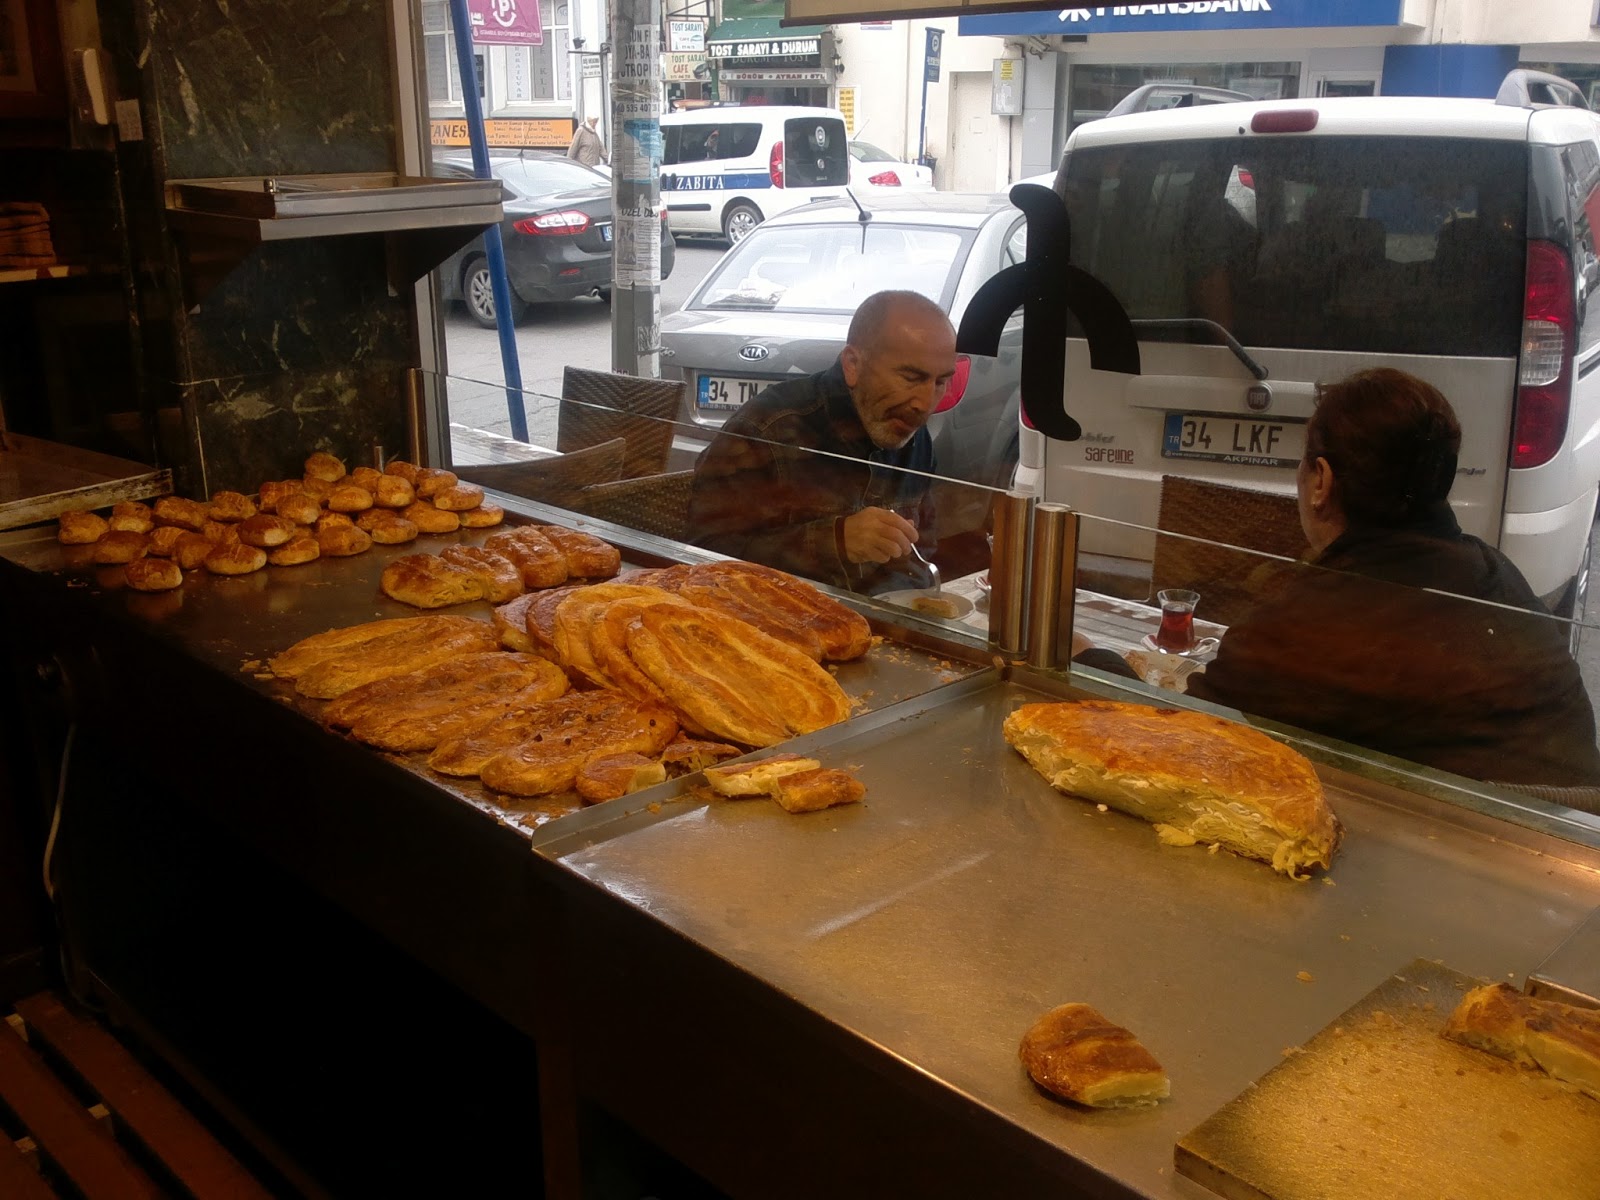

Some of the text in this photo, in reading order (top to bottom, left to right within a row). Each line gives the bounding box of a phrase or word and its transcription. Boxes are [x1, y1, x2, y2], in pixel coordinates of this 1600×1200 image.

[672, 23, 684, 31] TOST
[711, 44, 733, 57] TOST
[737, 42, 770, 56] SARAYI
[771, 42, 780, 54] &
[671, 55, 686, 63] TOST
[673, 64, 689, 74] CAFE
[431, 124, 468, 138] ANES
[677, 176, 724, 190] ZABITA
[744, 347, 762, 358] KIA
[701, 391, 709, 399] TR
[709, 380, 729, 402] 34
[1169, 420, 1282, 454] TR 34 LKF
[1223, 455, 1279, 466] AKPINAR
